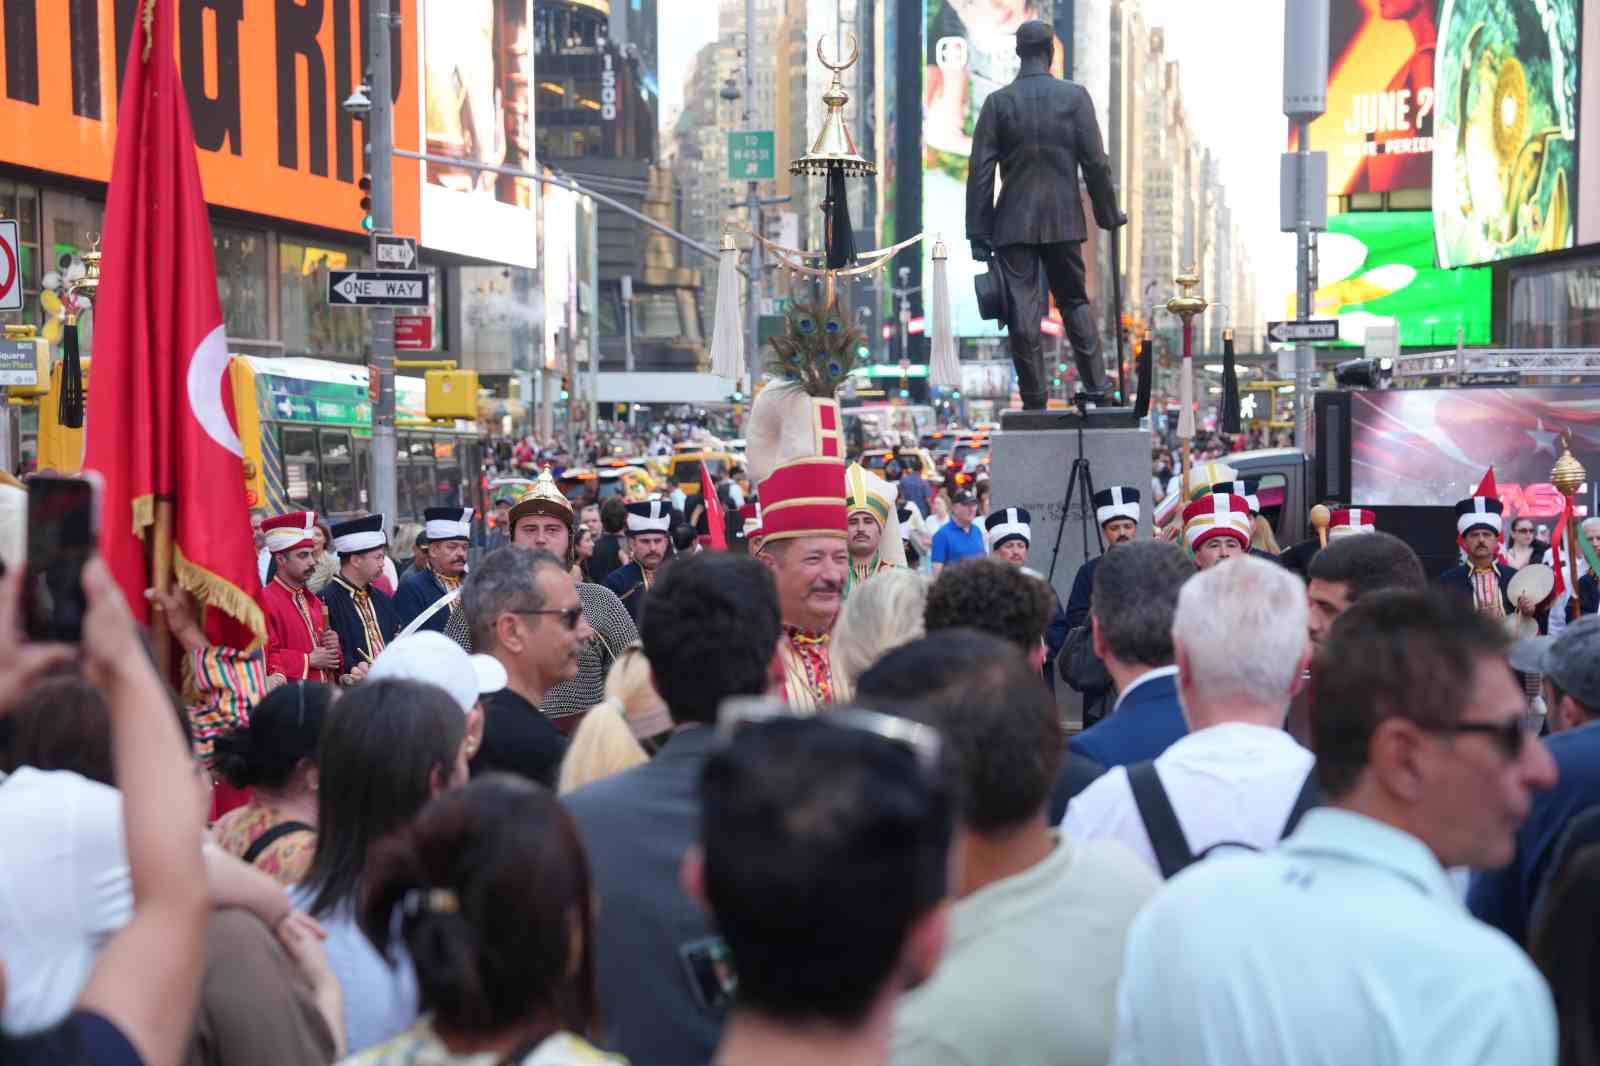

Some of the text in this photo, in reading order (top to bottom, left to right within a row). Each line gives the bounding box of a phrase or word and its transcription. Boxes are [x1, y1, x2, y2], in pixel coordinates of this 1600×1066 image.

[1343, 89, 1411, 134] JUNE
[744, 135, 760, 147] TO
[343, 281, 416, 297] ONE WAY
[1308, 326, 1329, 338] WAY
